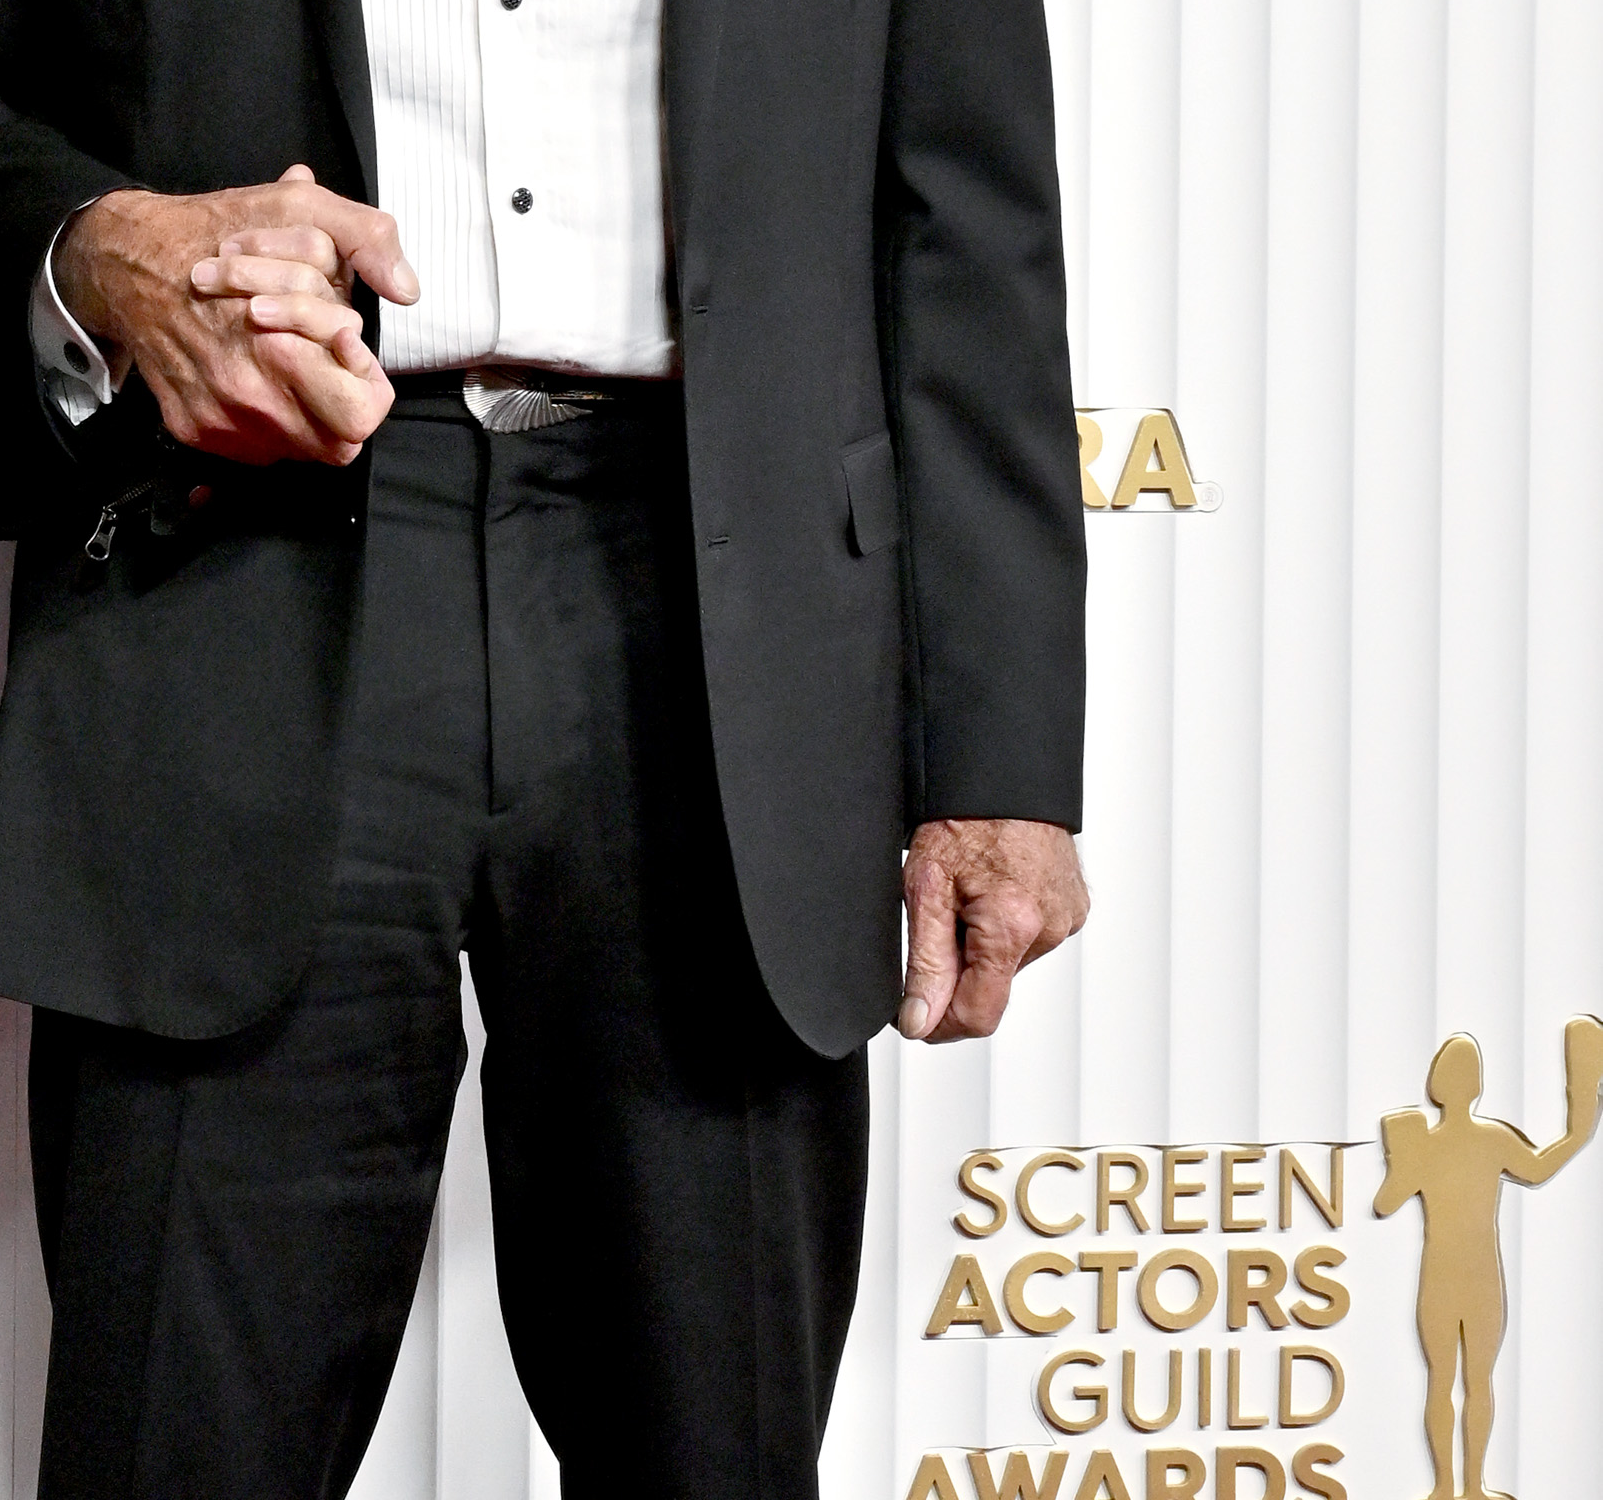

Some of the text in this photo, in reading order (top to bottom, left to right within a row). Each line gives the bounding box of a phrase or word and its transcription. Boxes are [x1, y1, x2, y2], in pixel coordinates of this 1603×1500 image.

[954, 1145, 1344, 1238] SCREEN
[925, 1246, 1352, 1339] ACTORS
[1038, 1345, 1346, 1434] GUILD
